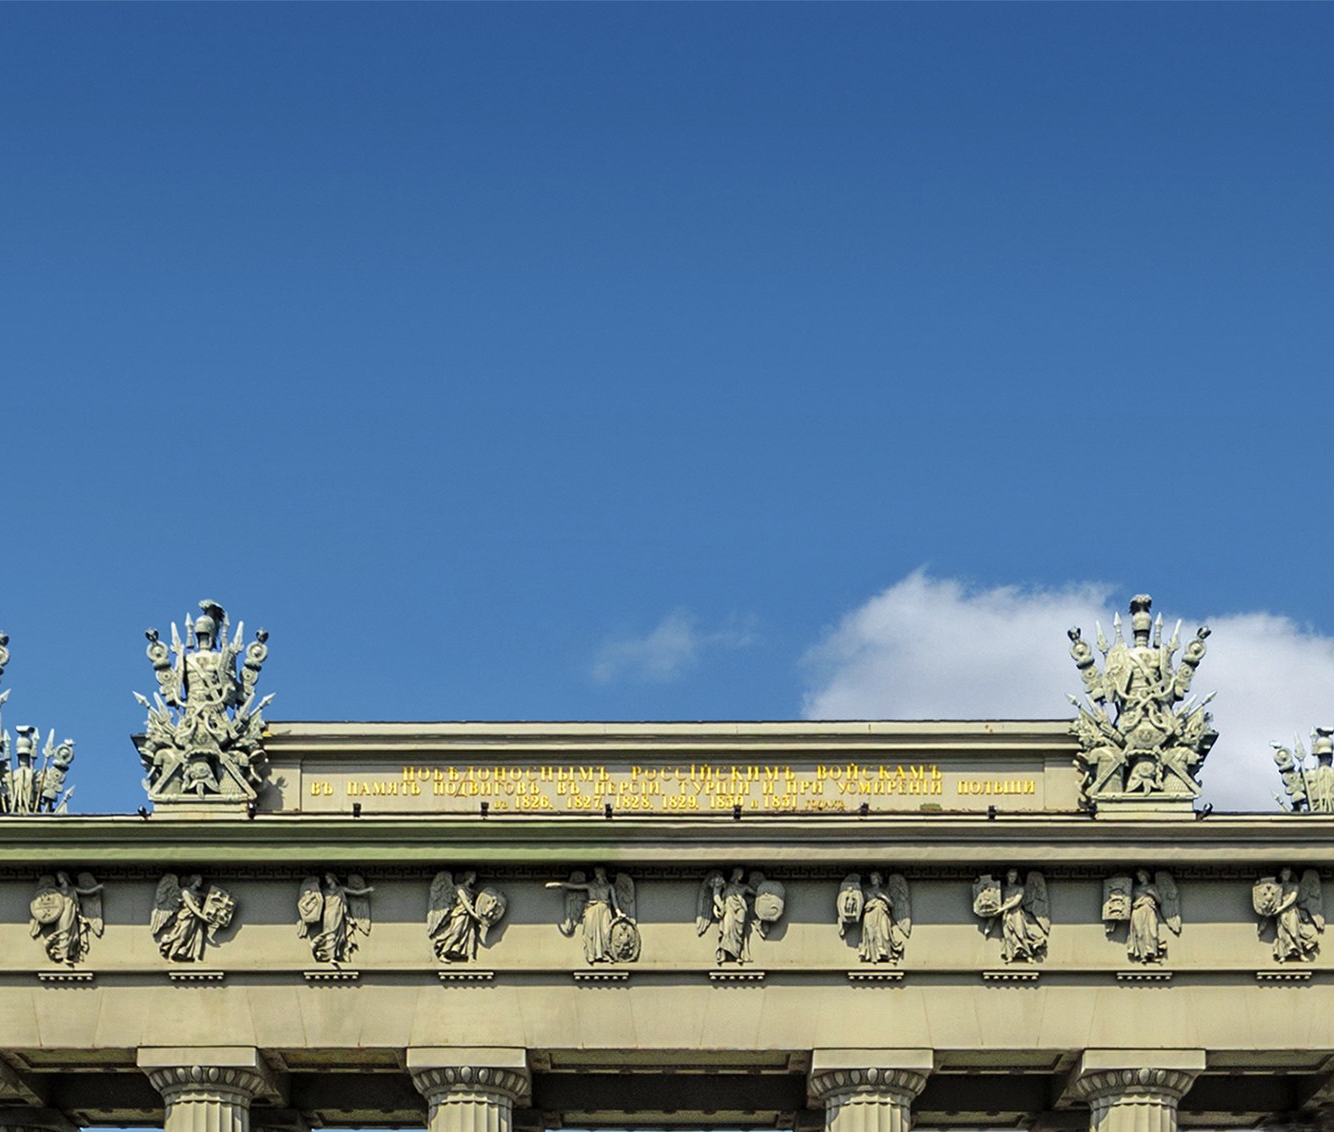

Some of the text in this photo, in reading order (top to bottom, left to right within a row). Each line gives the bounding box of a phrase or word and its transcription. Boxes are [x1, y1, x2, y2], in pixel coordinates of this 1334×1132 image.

[311, 782, 333, 796] ВЪ
[347, 782, 421, 796] ПАМЯТЬ
[557, 781, 580, 796] ВЪ
[787, 781, 823, 795] ПРИ
[957, 780, 1035, 794] ПОЛЬШИ
[764, 795, 797, 809] 1831
